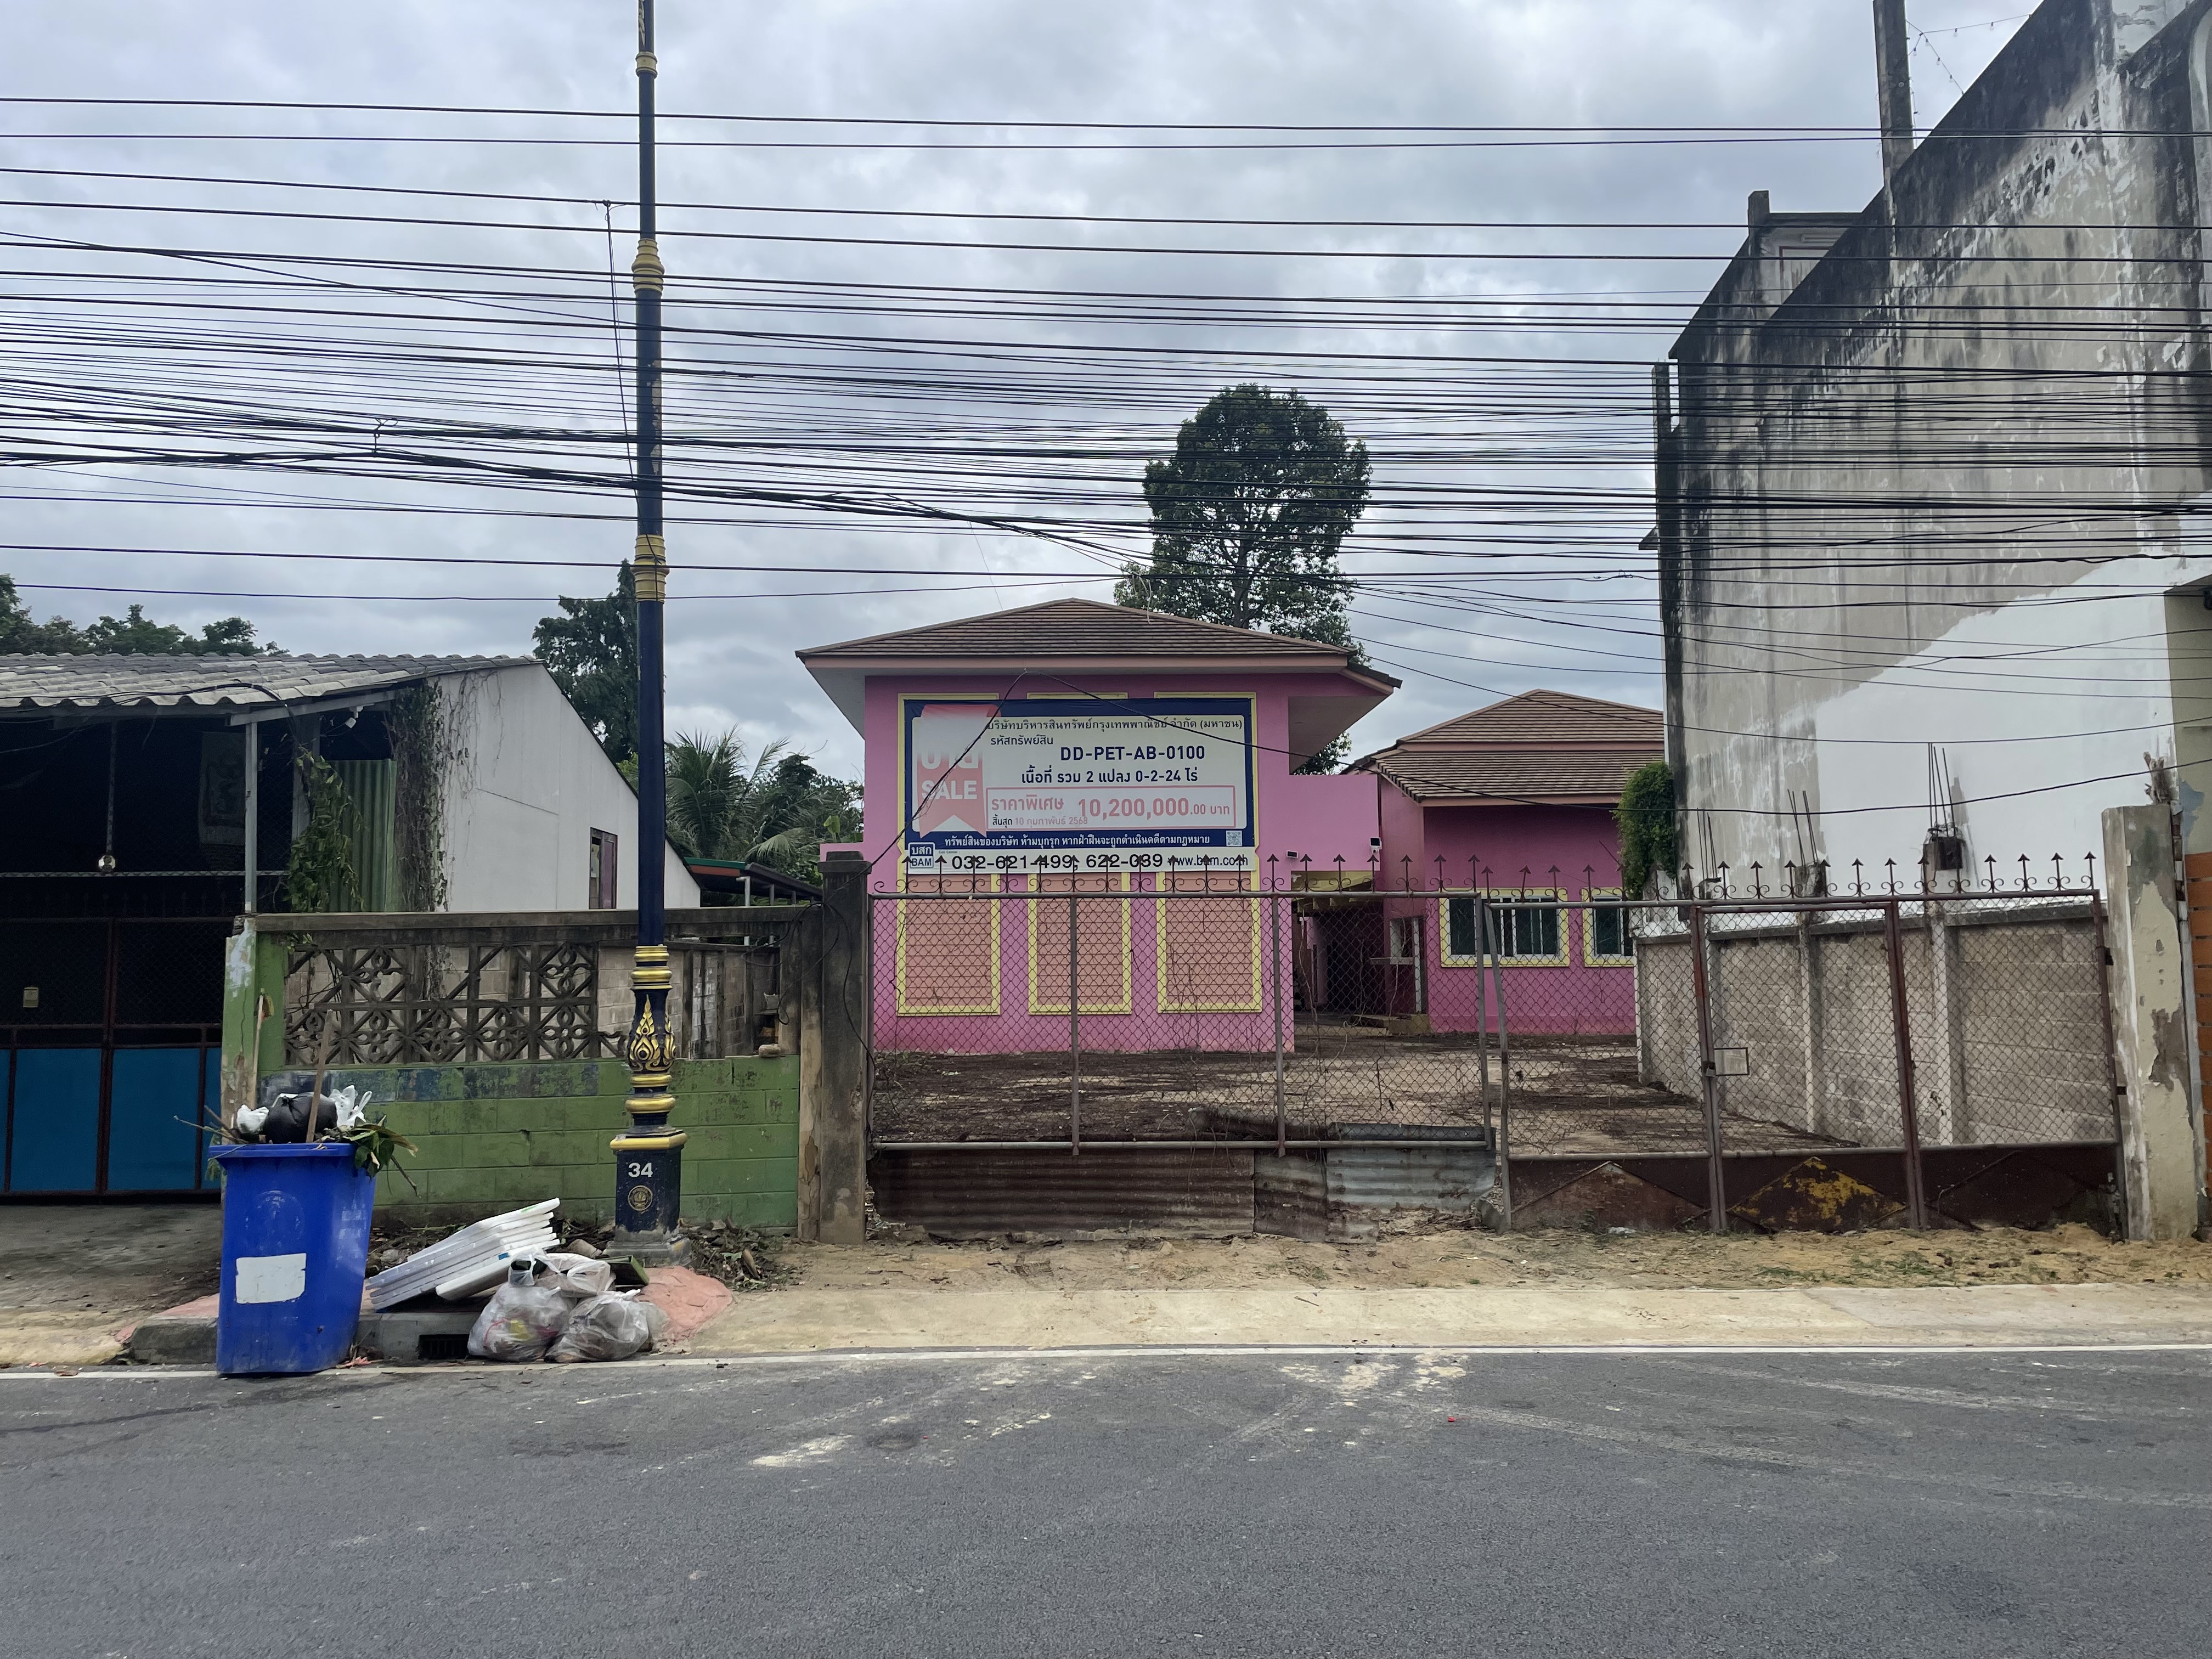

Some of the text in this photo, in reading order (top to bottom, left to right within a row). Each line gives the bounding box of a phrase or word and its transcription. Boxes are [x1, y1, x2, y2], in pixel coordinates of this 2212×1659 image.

[1200, 719, 1242, 729] (มหาชน)
[990, 734, 1053, 745] รหัสทรัพย์สิน
[1060, 746, 1205, 761] DD-PET-AB-0100
[1022, 765, 1198, 783] เนื้อที่ รวม 2 แปลง 0-2-24 ไร่
[921, 780, 977, 800] SALE
[991, 794, 1230, 821] ราคาพิเศษ 10,200,000.00 บาท
[992, 814, 1013, 828] สิ้นสุด
[1027, 816, 1066, 828] กุมภาพันธ์
[945, 834, 1019, 846] ทรัพย์สินของบริษัท
[1021, 834, 1060, 849] ห้ามบุกรุก
[911, 847, 932, 855] บสก
[911, 858, 932, 866] BAM
[628, 1163, 653, 1178] 34
